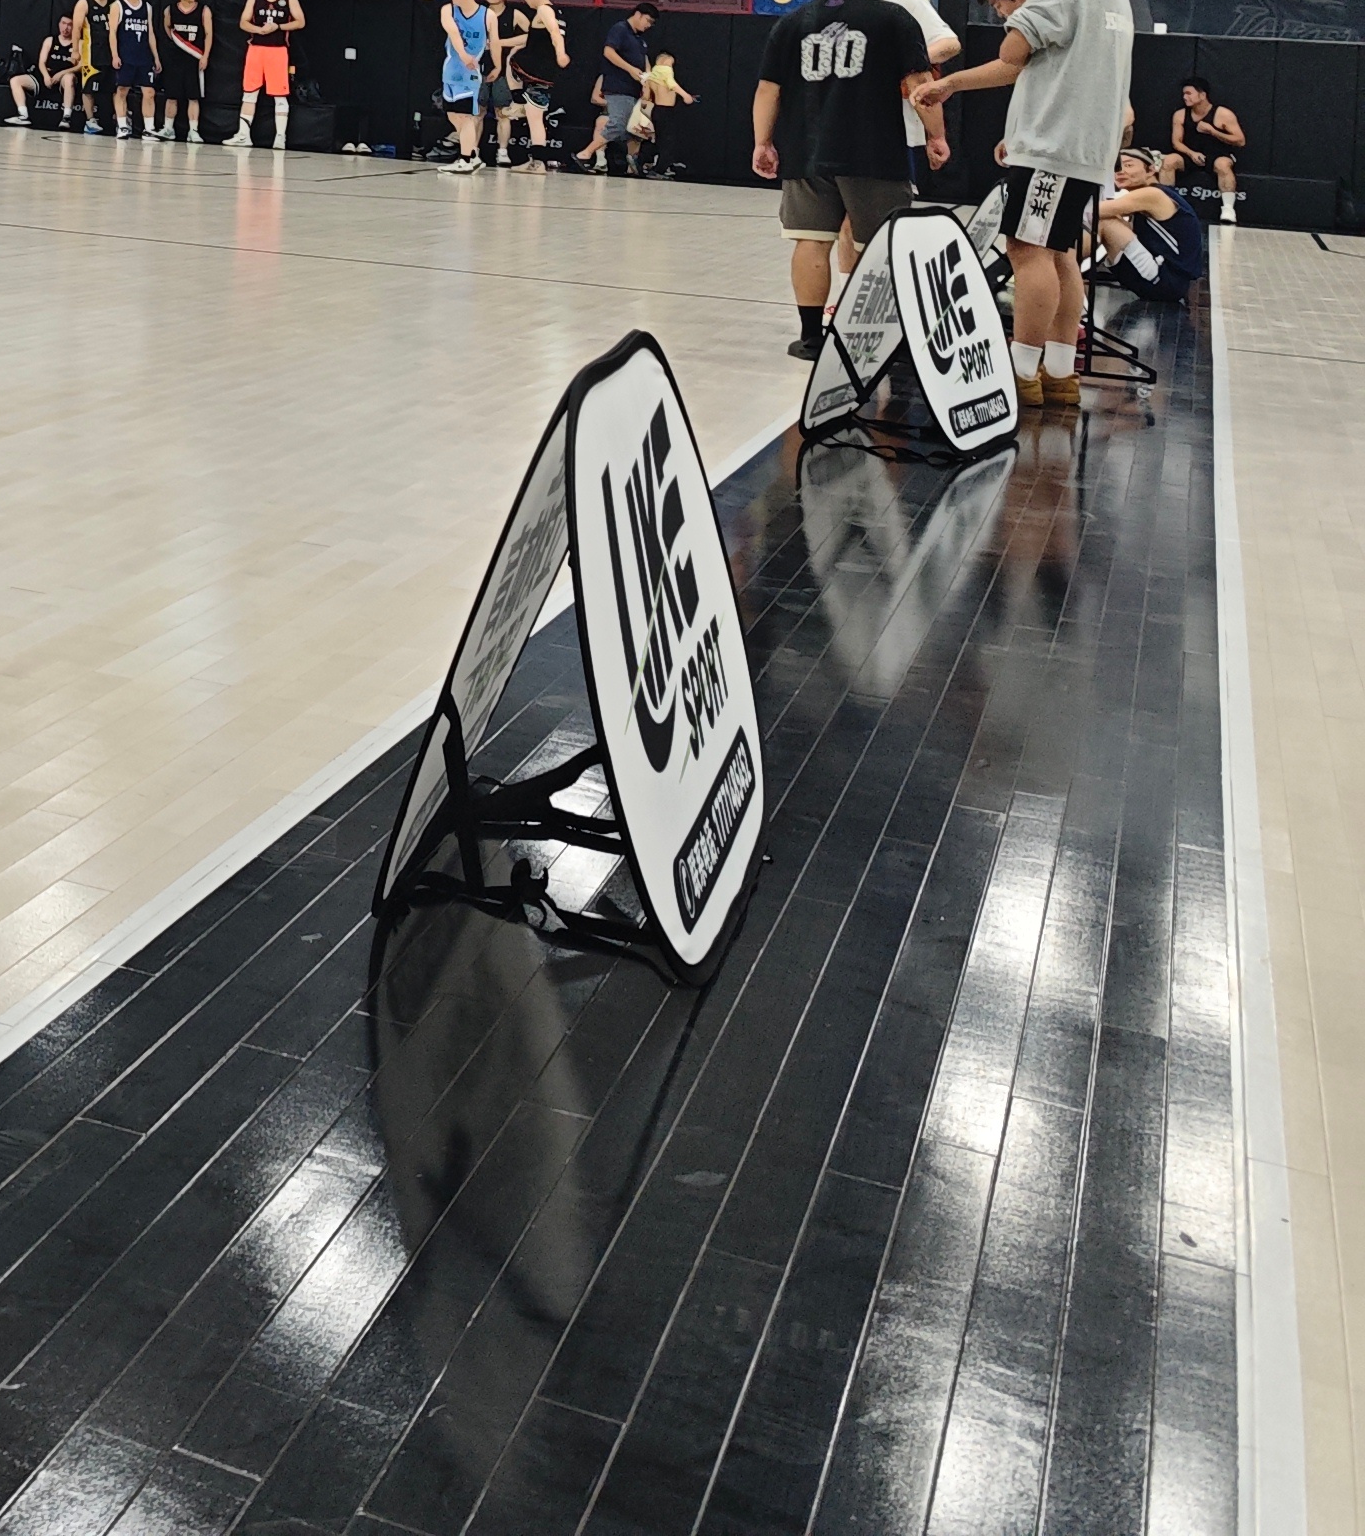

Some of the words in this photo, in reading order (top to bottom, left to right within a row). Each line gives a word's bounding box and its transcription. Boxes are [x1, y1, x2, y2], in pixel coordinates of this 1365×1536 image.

[135, 31, 142, 43] 7
[34, 99, 59, 111] Like
[519, 136, 563, 149] Sprts
[958, 338, 995, 385] SPORT
[601, 397, 700, 774] LIKE
[680, 613, 730, 761] SPORT
